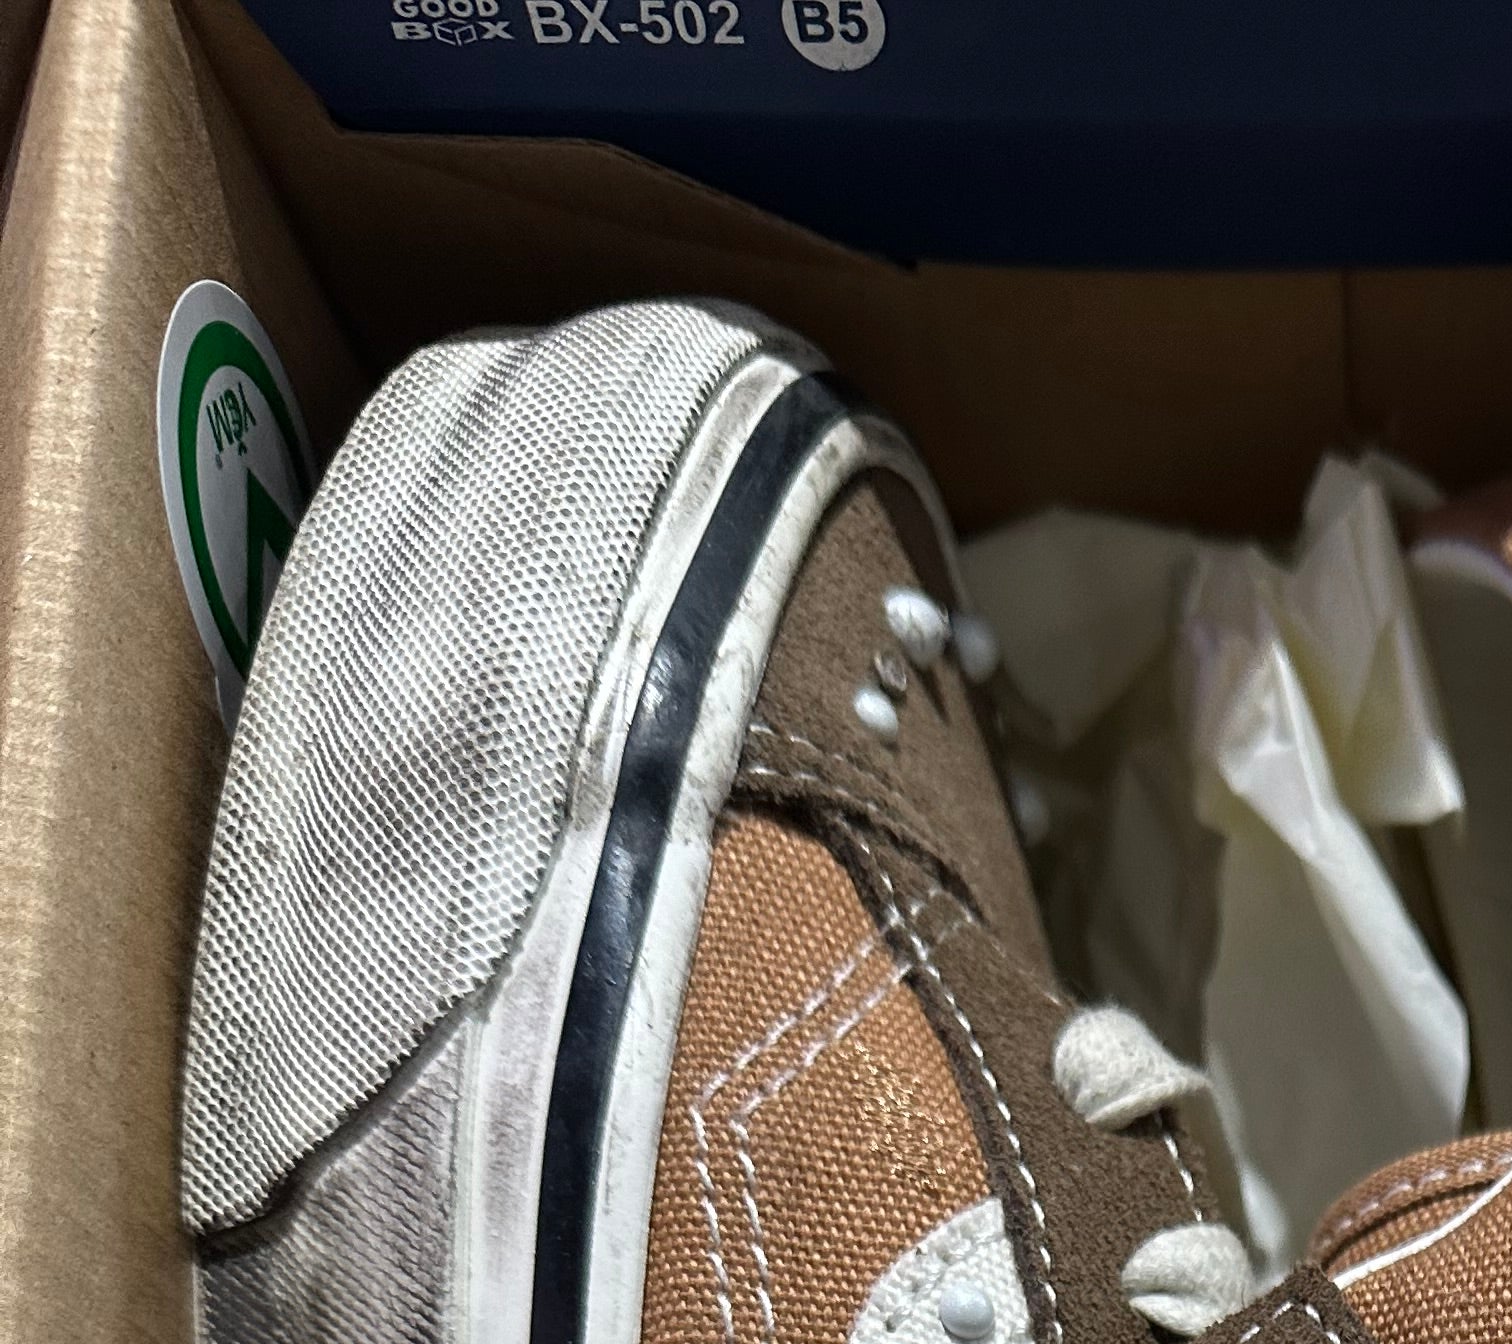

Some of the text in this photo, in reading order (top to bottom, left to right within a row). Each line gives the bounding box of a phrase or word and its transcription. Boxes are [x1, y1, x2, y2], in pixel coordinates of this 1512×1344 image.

[393, 0, 499, 18] GOOD
[525, 0, 745, 44] BX-502
[793, 0, 868, 44] B5
